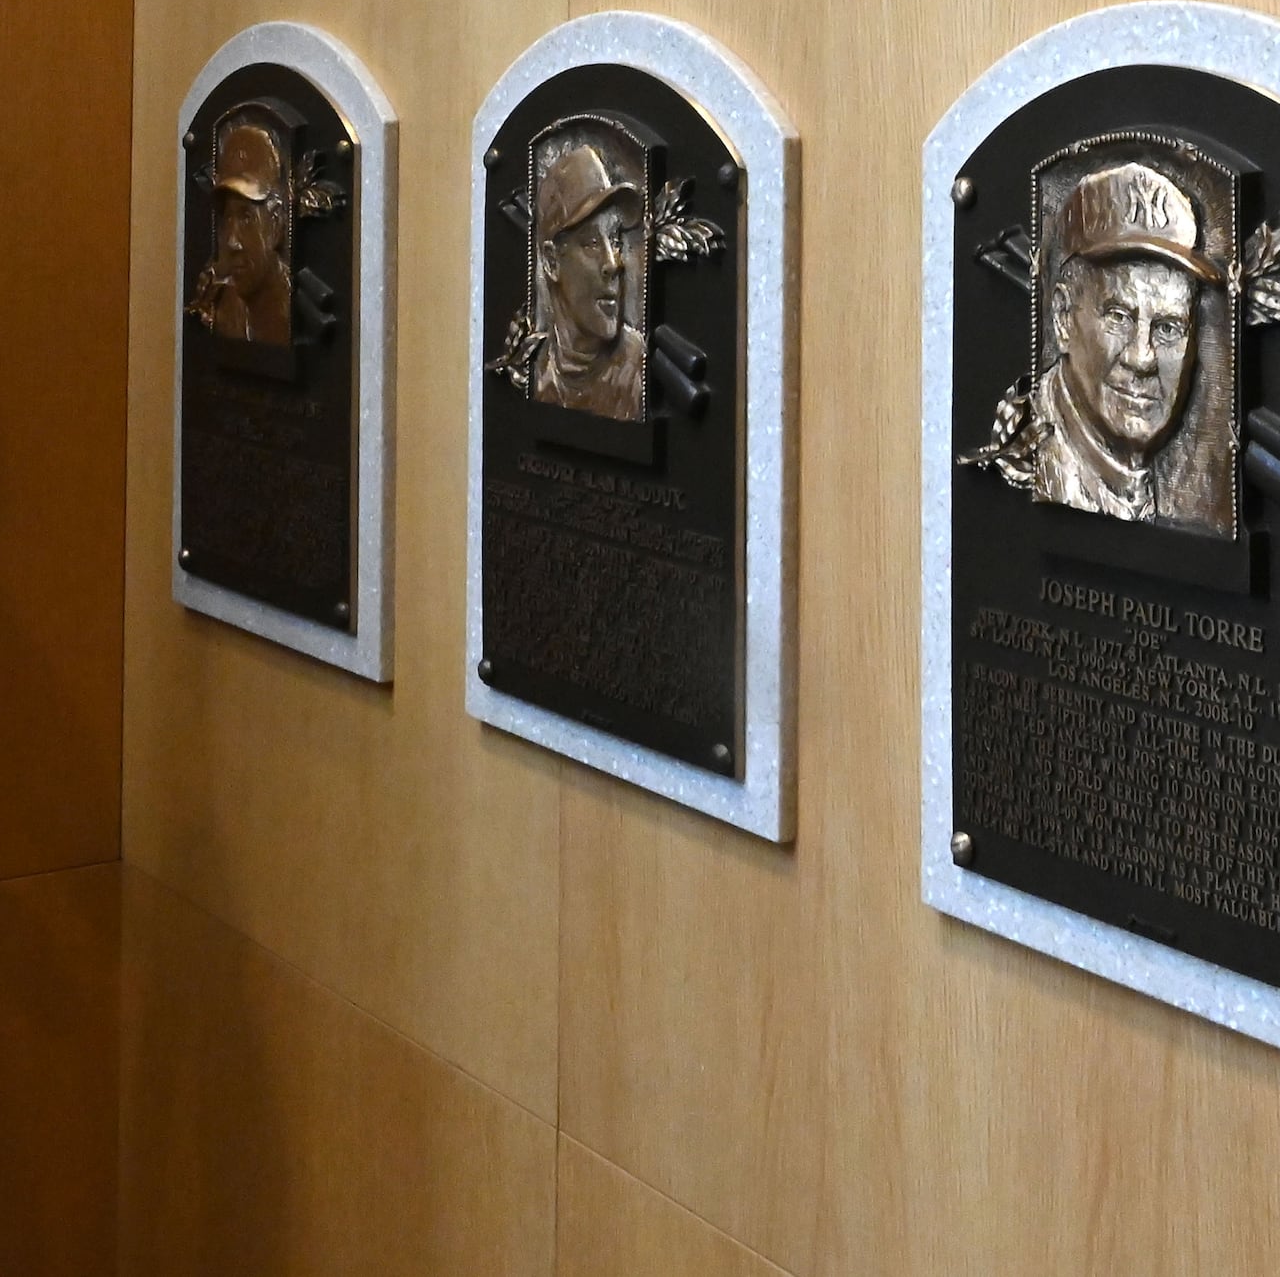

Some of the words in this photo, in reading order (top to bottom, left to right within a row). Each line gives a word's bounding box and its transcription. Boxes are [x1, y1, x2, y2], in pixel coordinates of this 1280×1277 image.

[1039, 577, 1115, 618] JOSEPH
[1122, 596, 1178, 633] PAUL
[1184, 611, 1265, 653] TORRE
[1125, 627, 1167, 650] "JOE"
[1048, 659, 1075, 683] LOS
[1079, 668, 1153, 704] ANGELES,
[1194, 698, 1253, 731] 2008-10
[1136, 665, 1170, 690] NEW
[1154, 650, 1233, 688] ATLANTA,
[1049, 722, 1104, 754] YANKEES
[1112, 741, 1126, 761] TO
[1228, 775, 1242, 796] IN
[1109, 700, 1135, 725] AND
[1140, 709, 1200, 744] STATURE
[1207, 728, 1222, 750] IN
[1226, 734, 1255, 760] THE
[1101, 757, 1159, 791] WINNING
[1184, 782, 1245, 818] DIVISION
[1109, 779, 1152, 809] SERIES
[1160, 795, 1216, 829] CROWNS
[1225, 815, 1239, 837] IN
[1055, 780, 1106, 813] PILOTED
[1112, 798, 1159, 831] BRAVES
[1166, 816, 1180, 838] TO
[1186, 822, 1274, 869] POSTSEASON
[1110, 837, 1164, 872] SEASONS
[1171, 858, 1186, 880] AS
[1146, 829, 1212, 868] MANAGER
[1215, 853, 1233, 875] OF
[1236, 860, 1264, 886] THE
[1174, 879, 1209, 909] MOST
